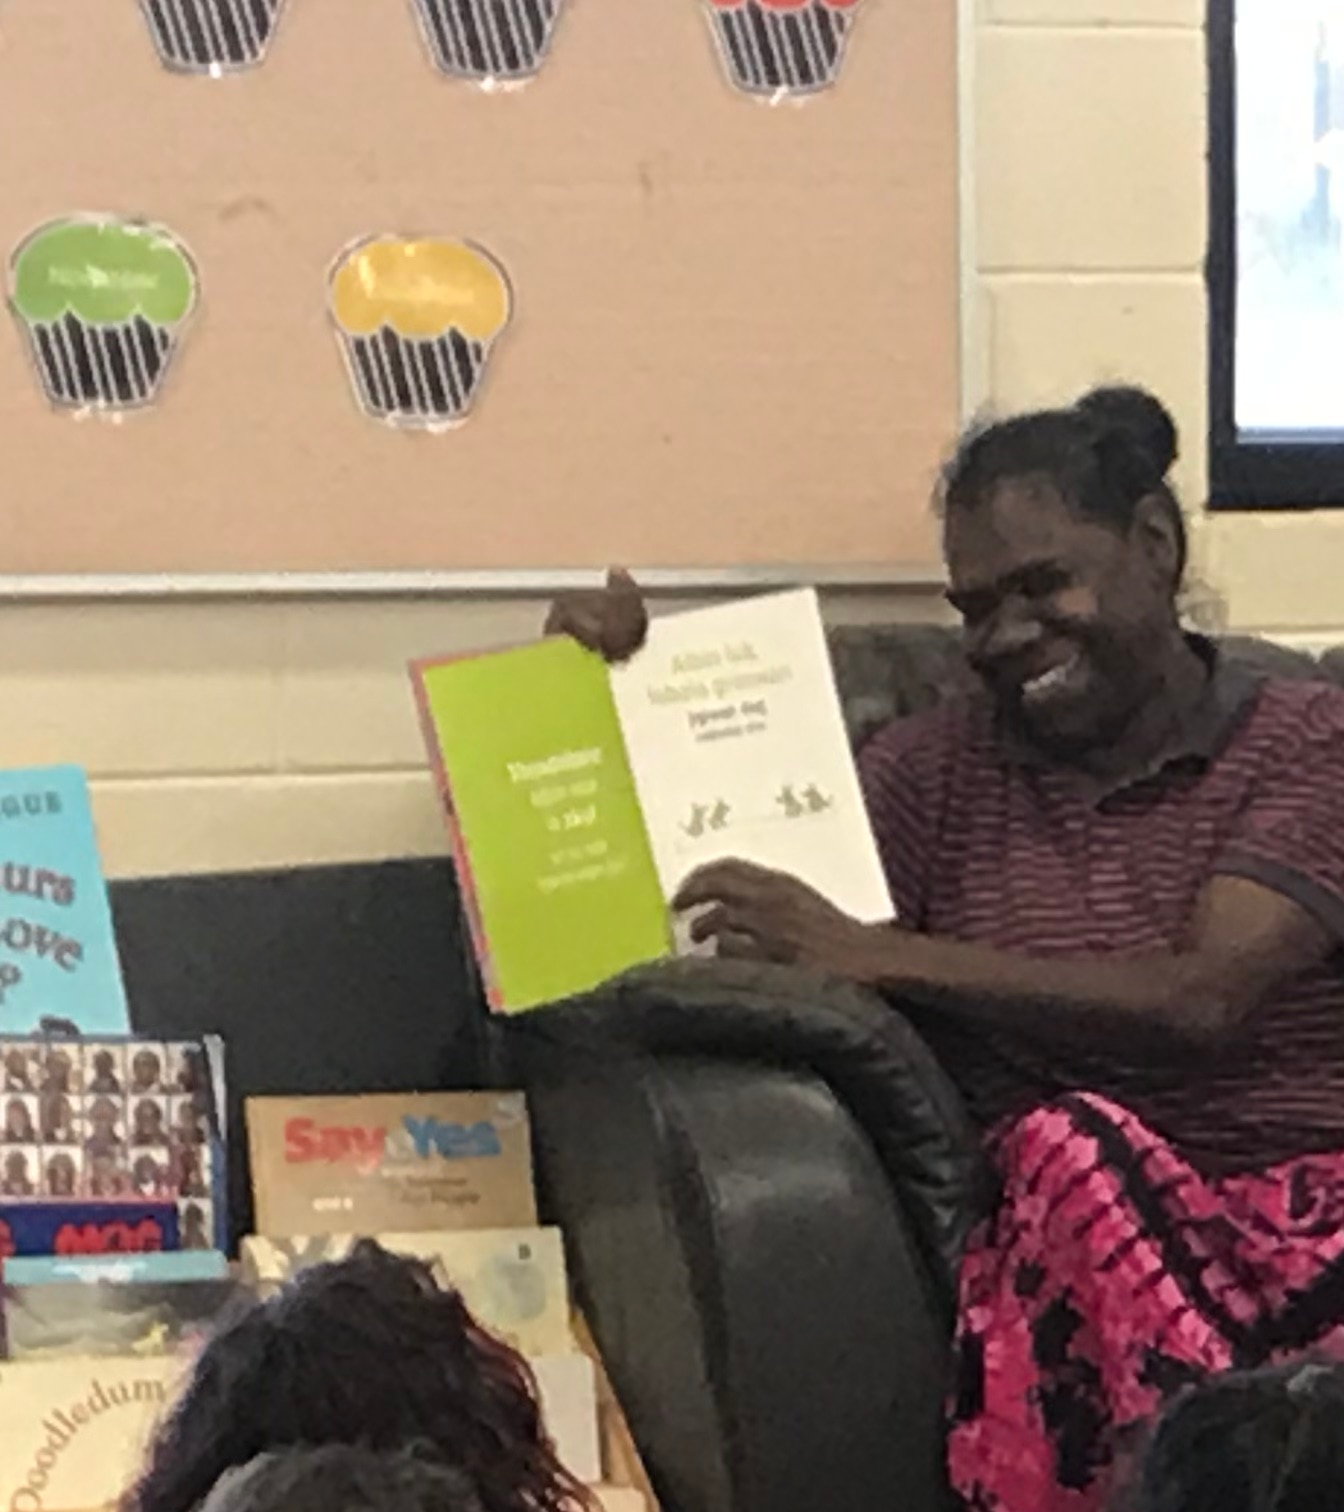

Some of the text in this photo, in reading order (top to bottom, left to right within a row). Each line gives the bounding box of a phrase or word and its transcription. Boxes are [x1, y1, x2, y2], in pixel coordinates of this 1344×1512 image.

[0, 917, 84, 973] ove
[284, 1117, 387, 1175] Say
[10, 1377, 167, 1512] Doodledum
